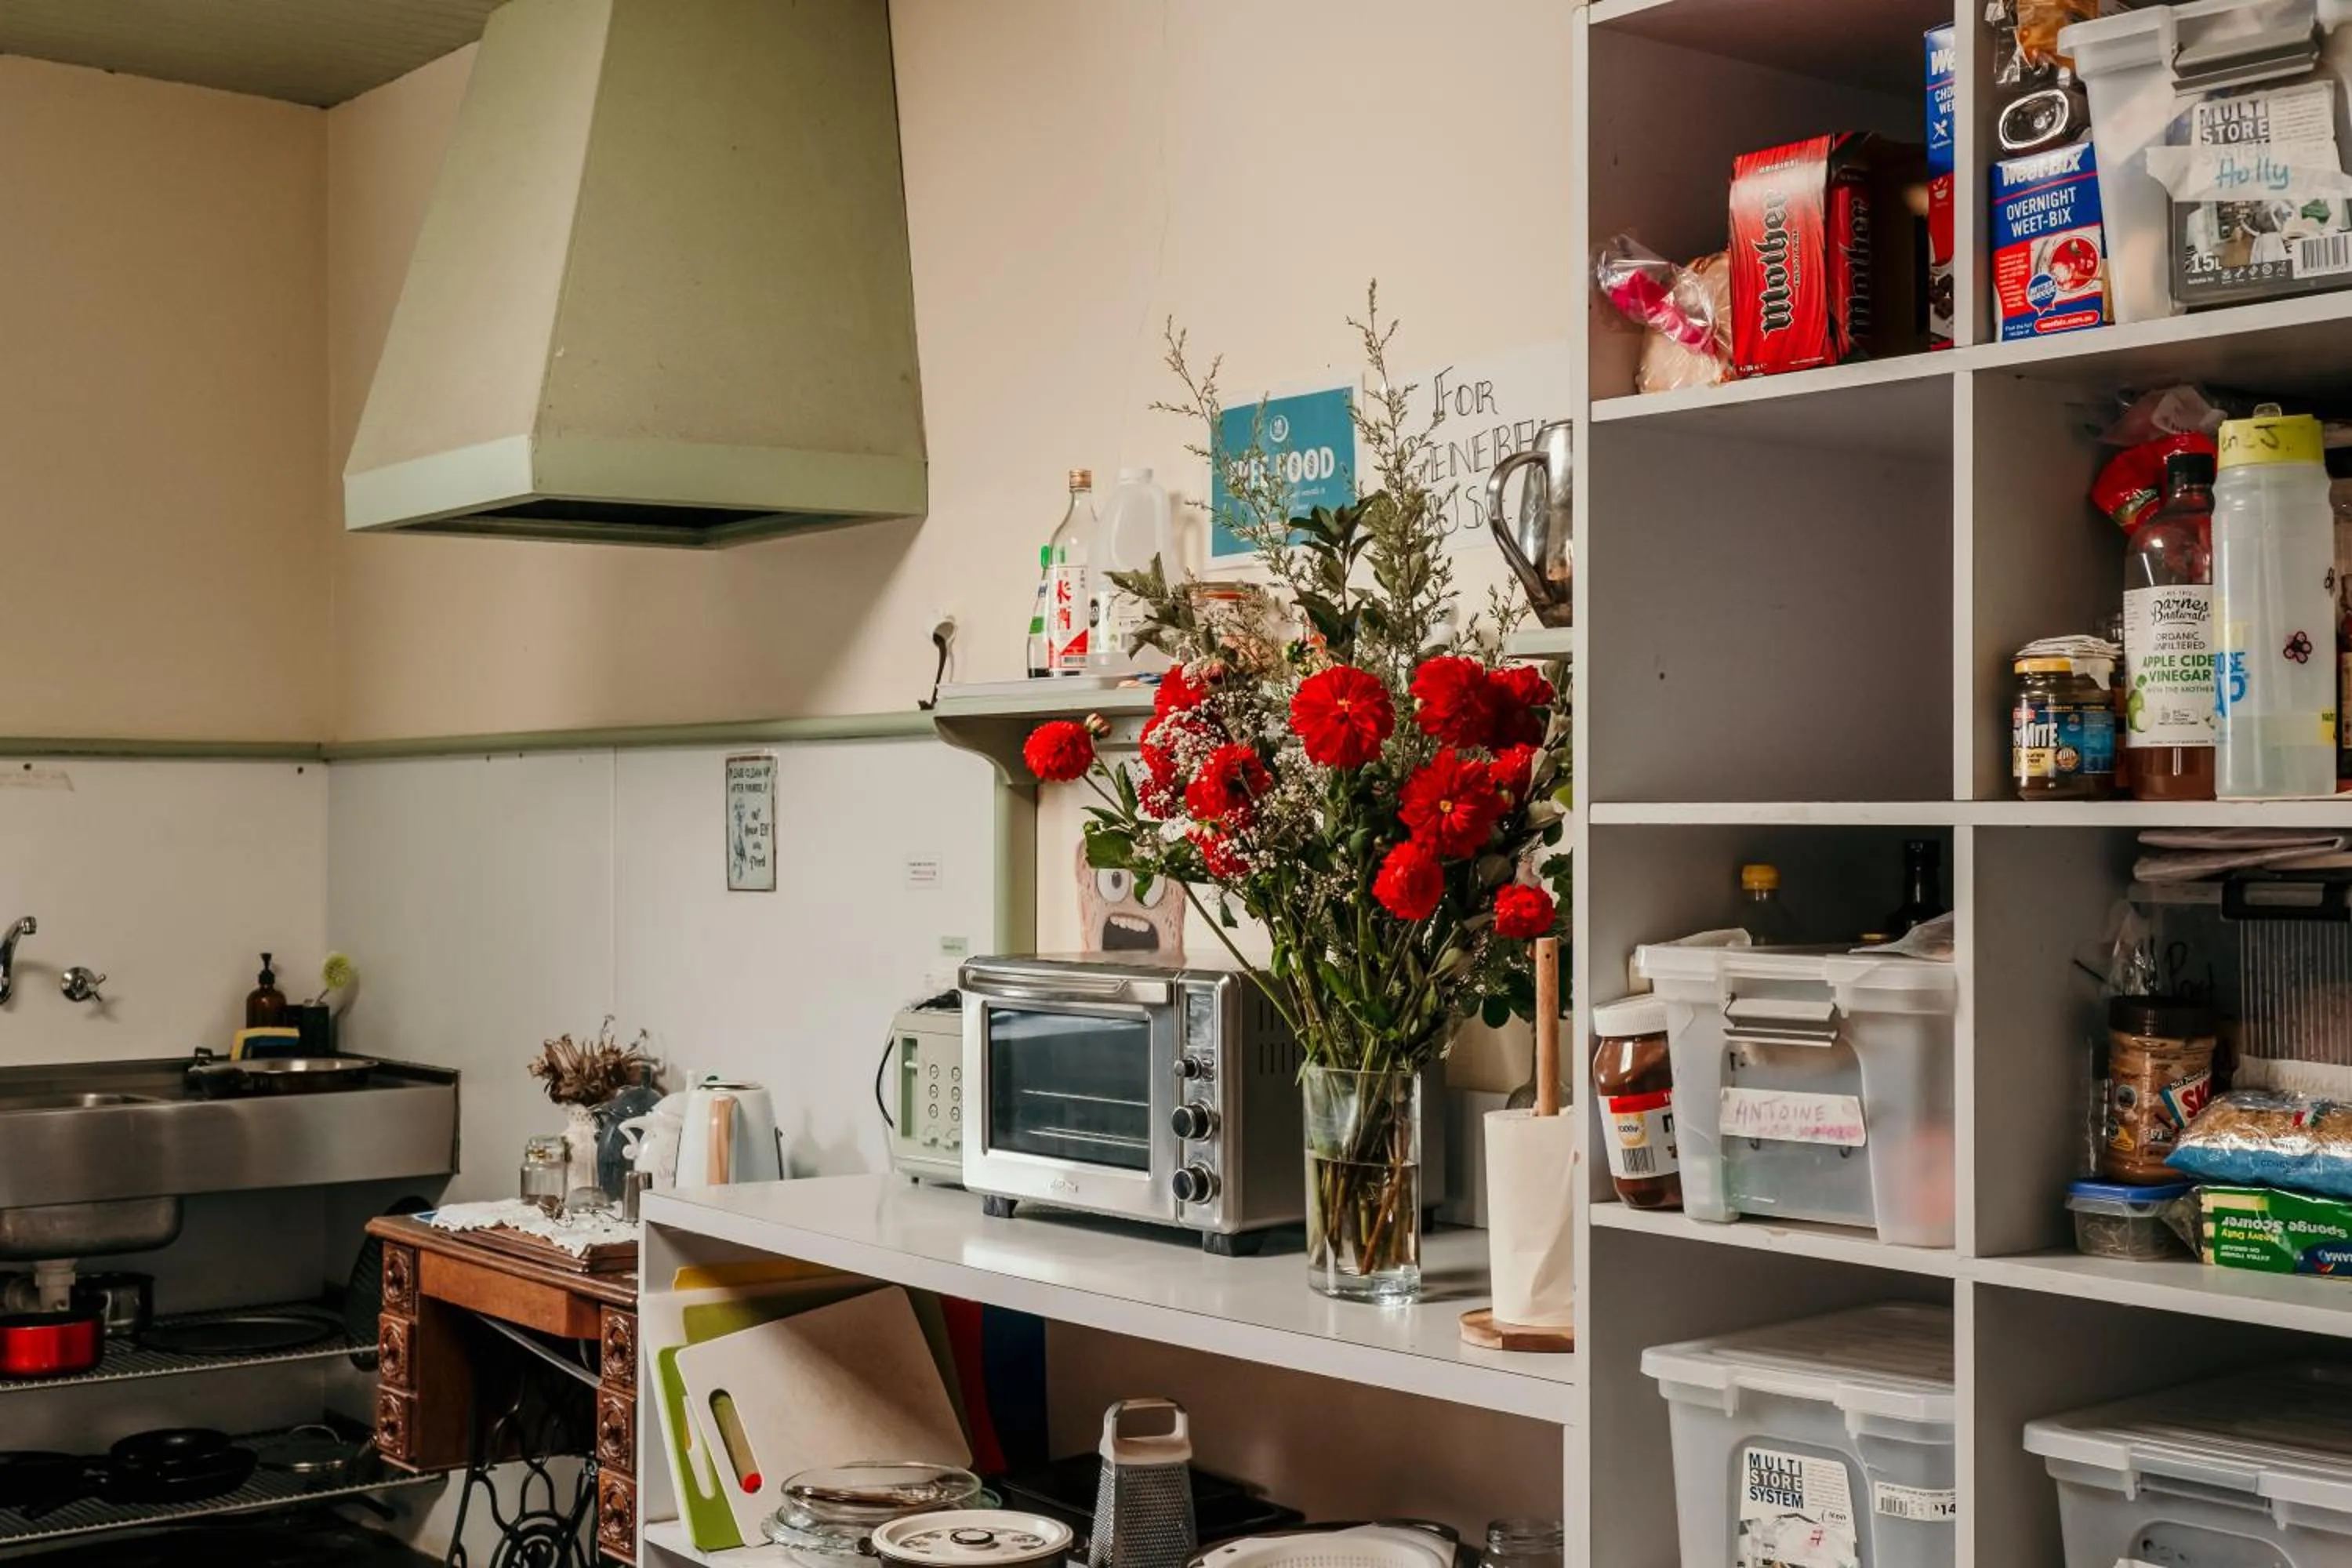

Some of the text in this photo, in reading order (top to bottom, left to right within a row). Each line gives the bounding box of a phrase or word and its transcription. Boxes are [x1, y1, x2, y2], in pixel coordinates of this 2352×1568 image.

[2199, 99, 2269, 125] MULTI
[2201, 118, 2270, 145] STORE
[2216, 158, 2290, 190] Holly
[2006, 187, 2077, 220] OVERNIGHT
[2012, 207, 2072, 237] WEET-BIX
[1401, 419, 1547, 485] GENERA
[1428, 483, 1486, 536] US
[2151, 597, 2209, 626] Barnes
[2156, 631, 2199, 641] ORGANIC
[2143, 654, 2216, 668] APPLE CIDE
[2149, 670, 2212, 682] VINEGAR
[1735, 1101, 1826, 1124] ANTOINE
[2221, 1216, 2348, 1239] Sponge Scourer
[2221, 1229, 2278, 1243] Heavy Duty
[1748, 1453, 1802, 1475] MULTI
[1750, 1468, 1802, 1492] STORE
[1749, 1486, 1804, 1509] SYSTEM
